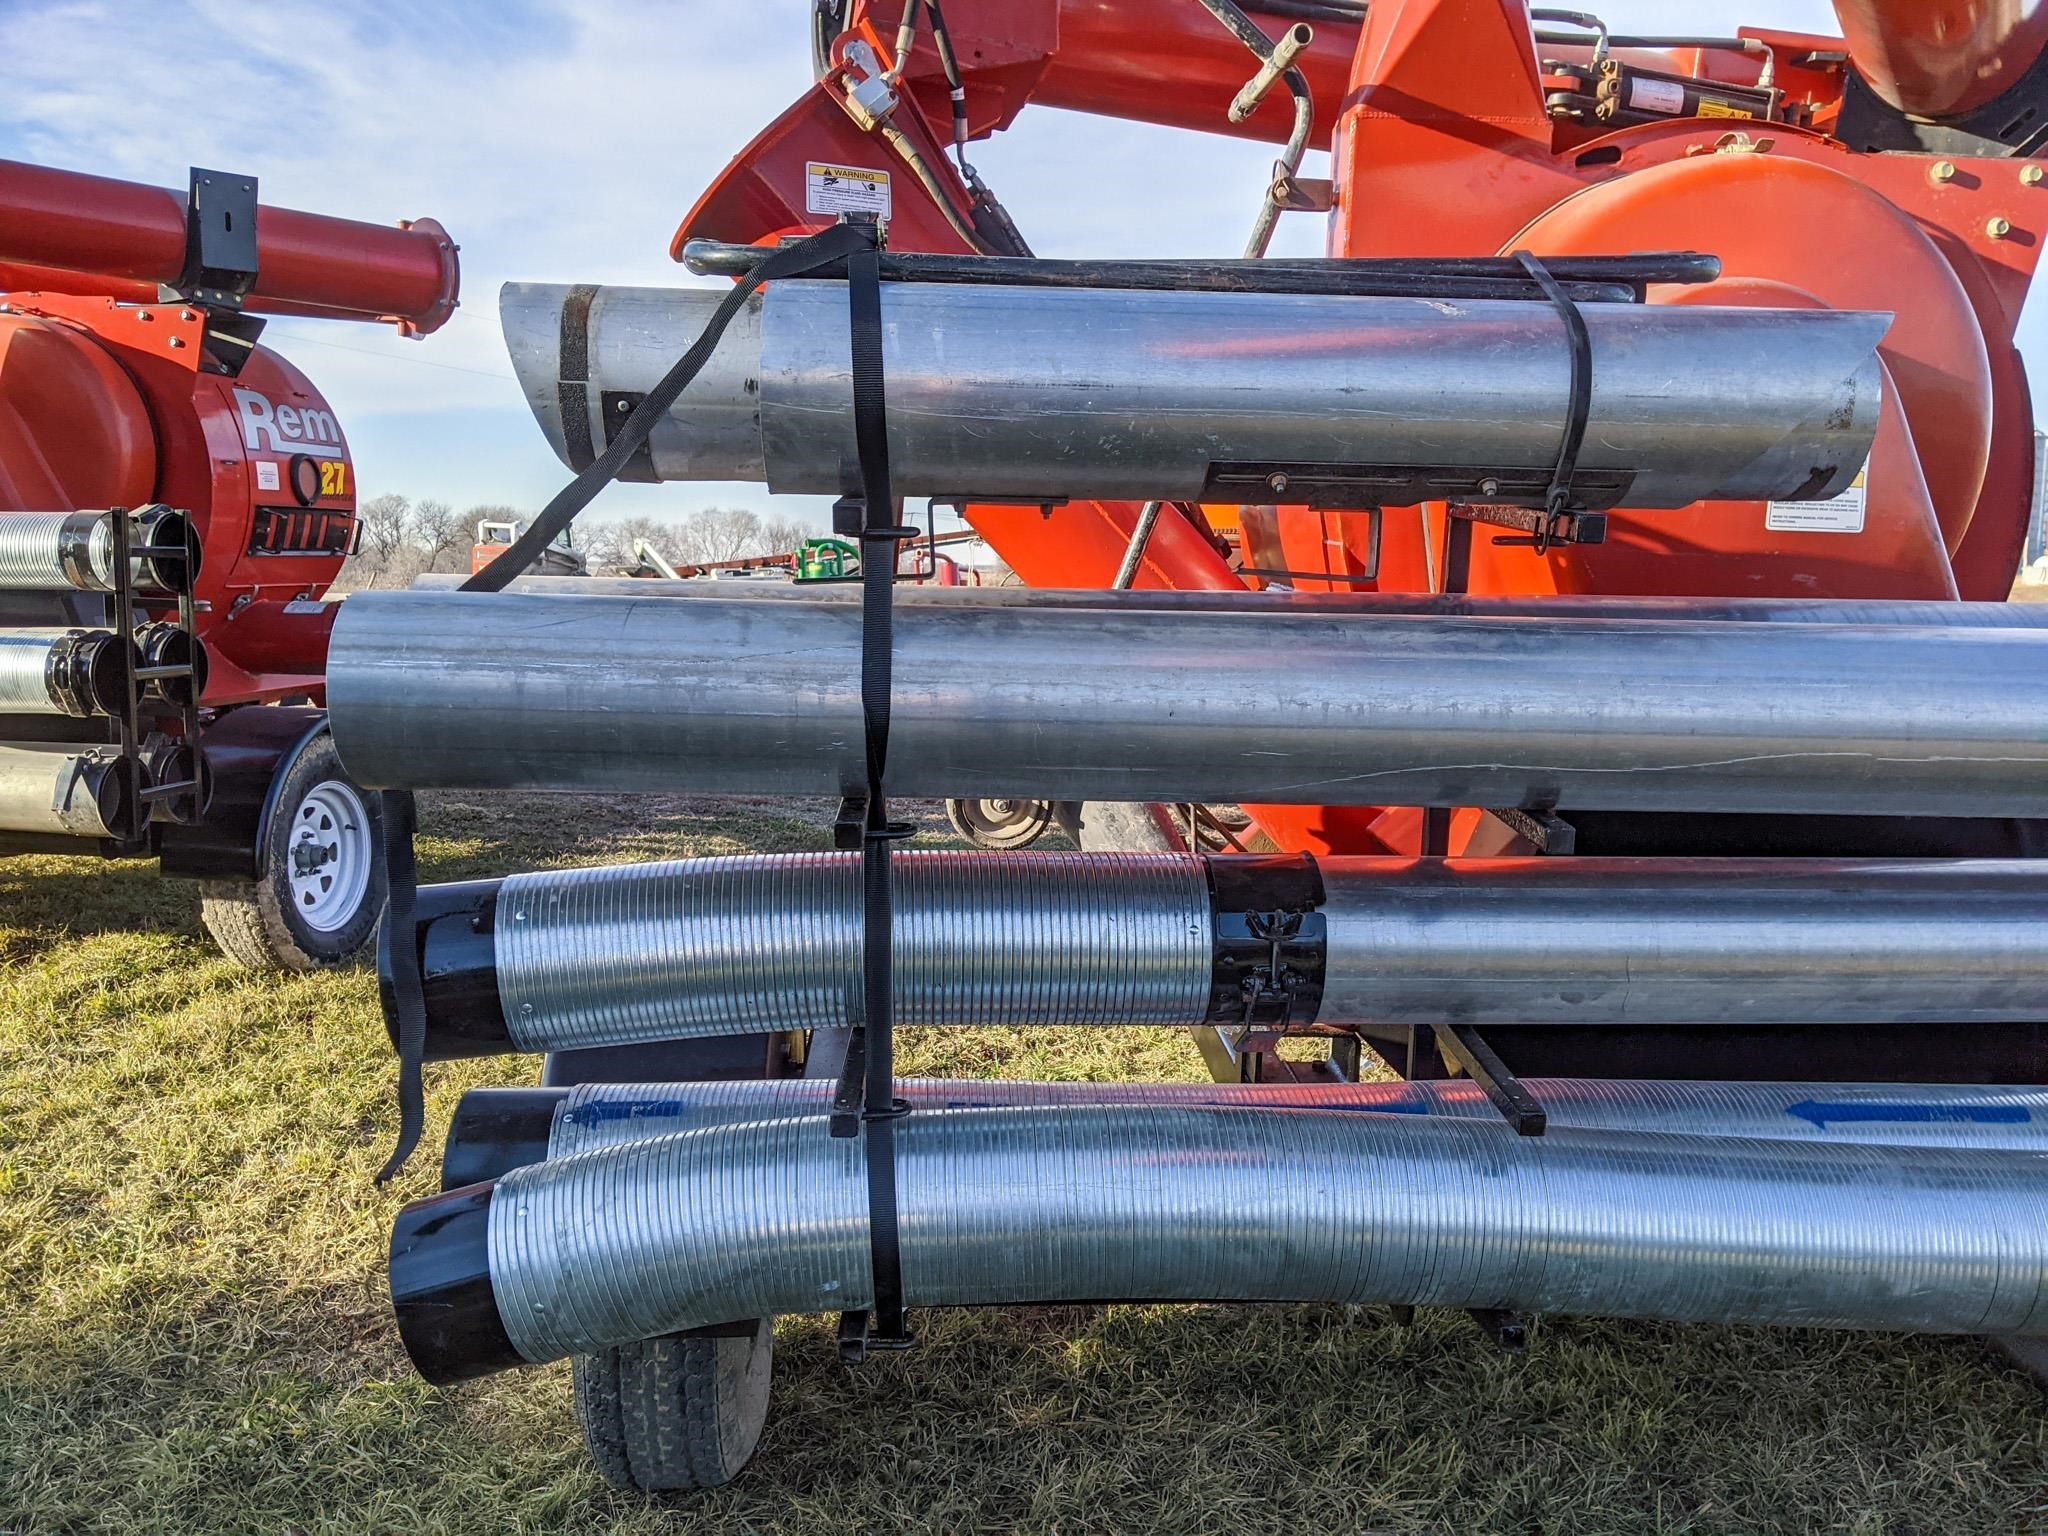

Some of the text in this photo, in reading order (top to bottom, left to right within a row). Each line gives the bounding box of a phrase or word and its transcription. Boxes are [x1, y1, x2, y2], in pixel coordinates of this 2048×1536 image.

[834, 169, 875, 181] WARNING
[232, 388, 342, 457] Rem
[321, 461, 345, 496] 27
